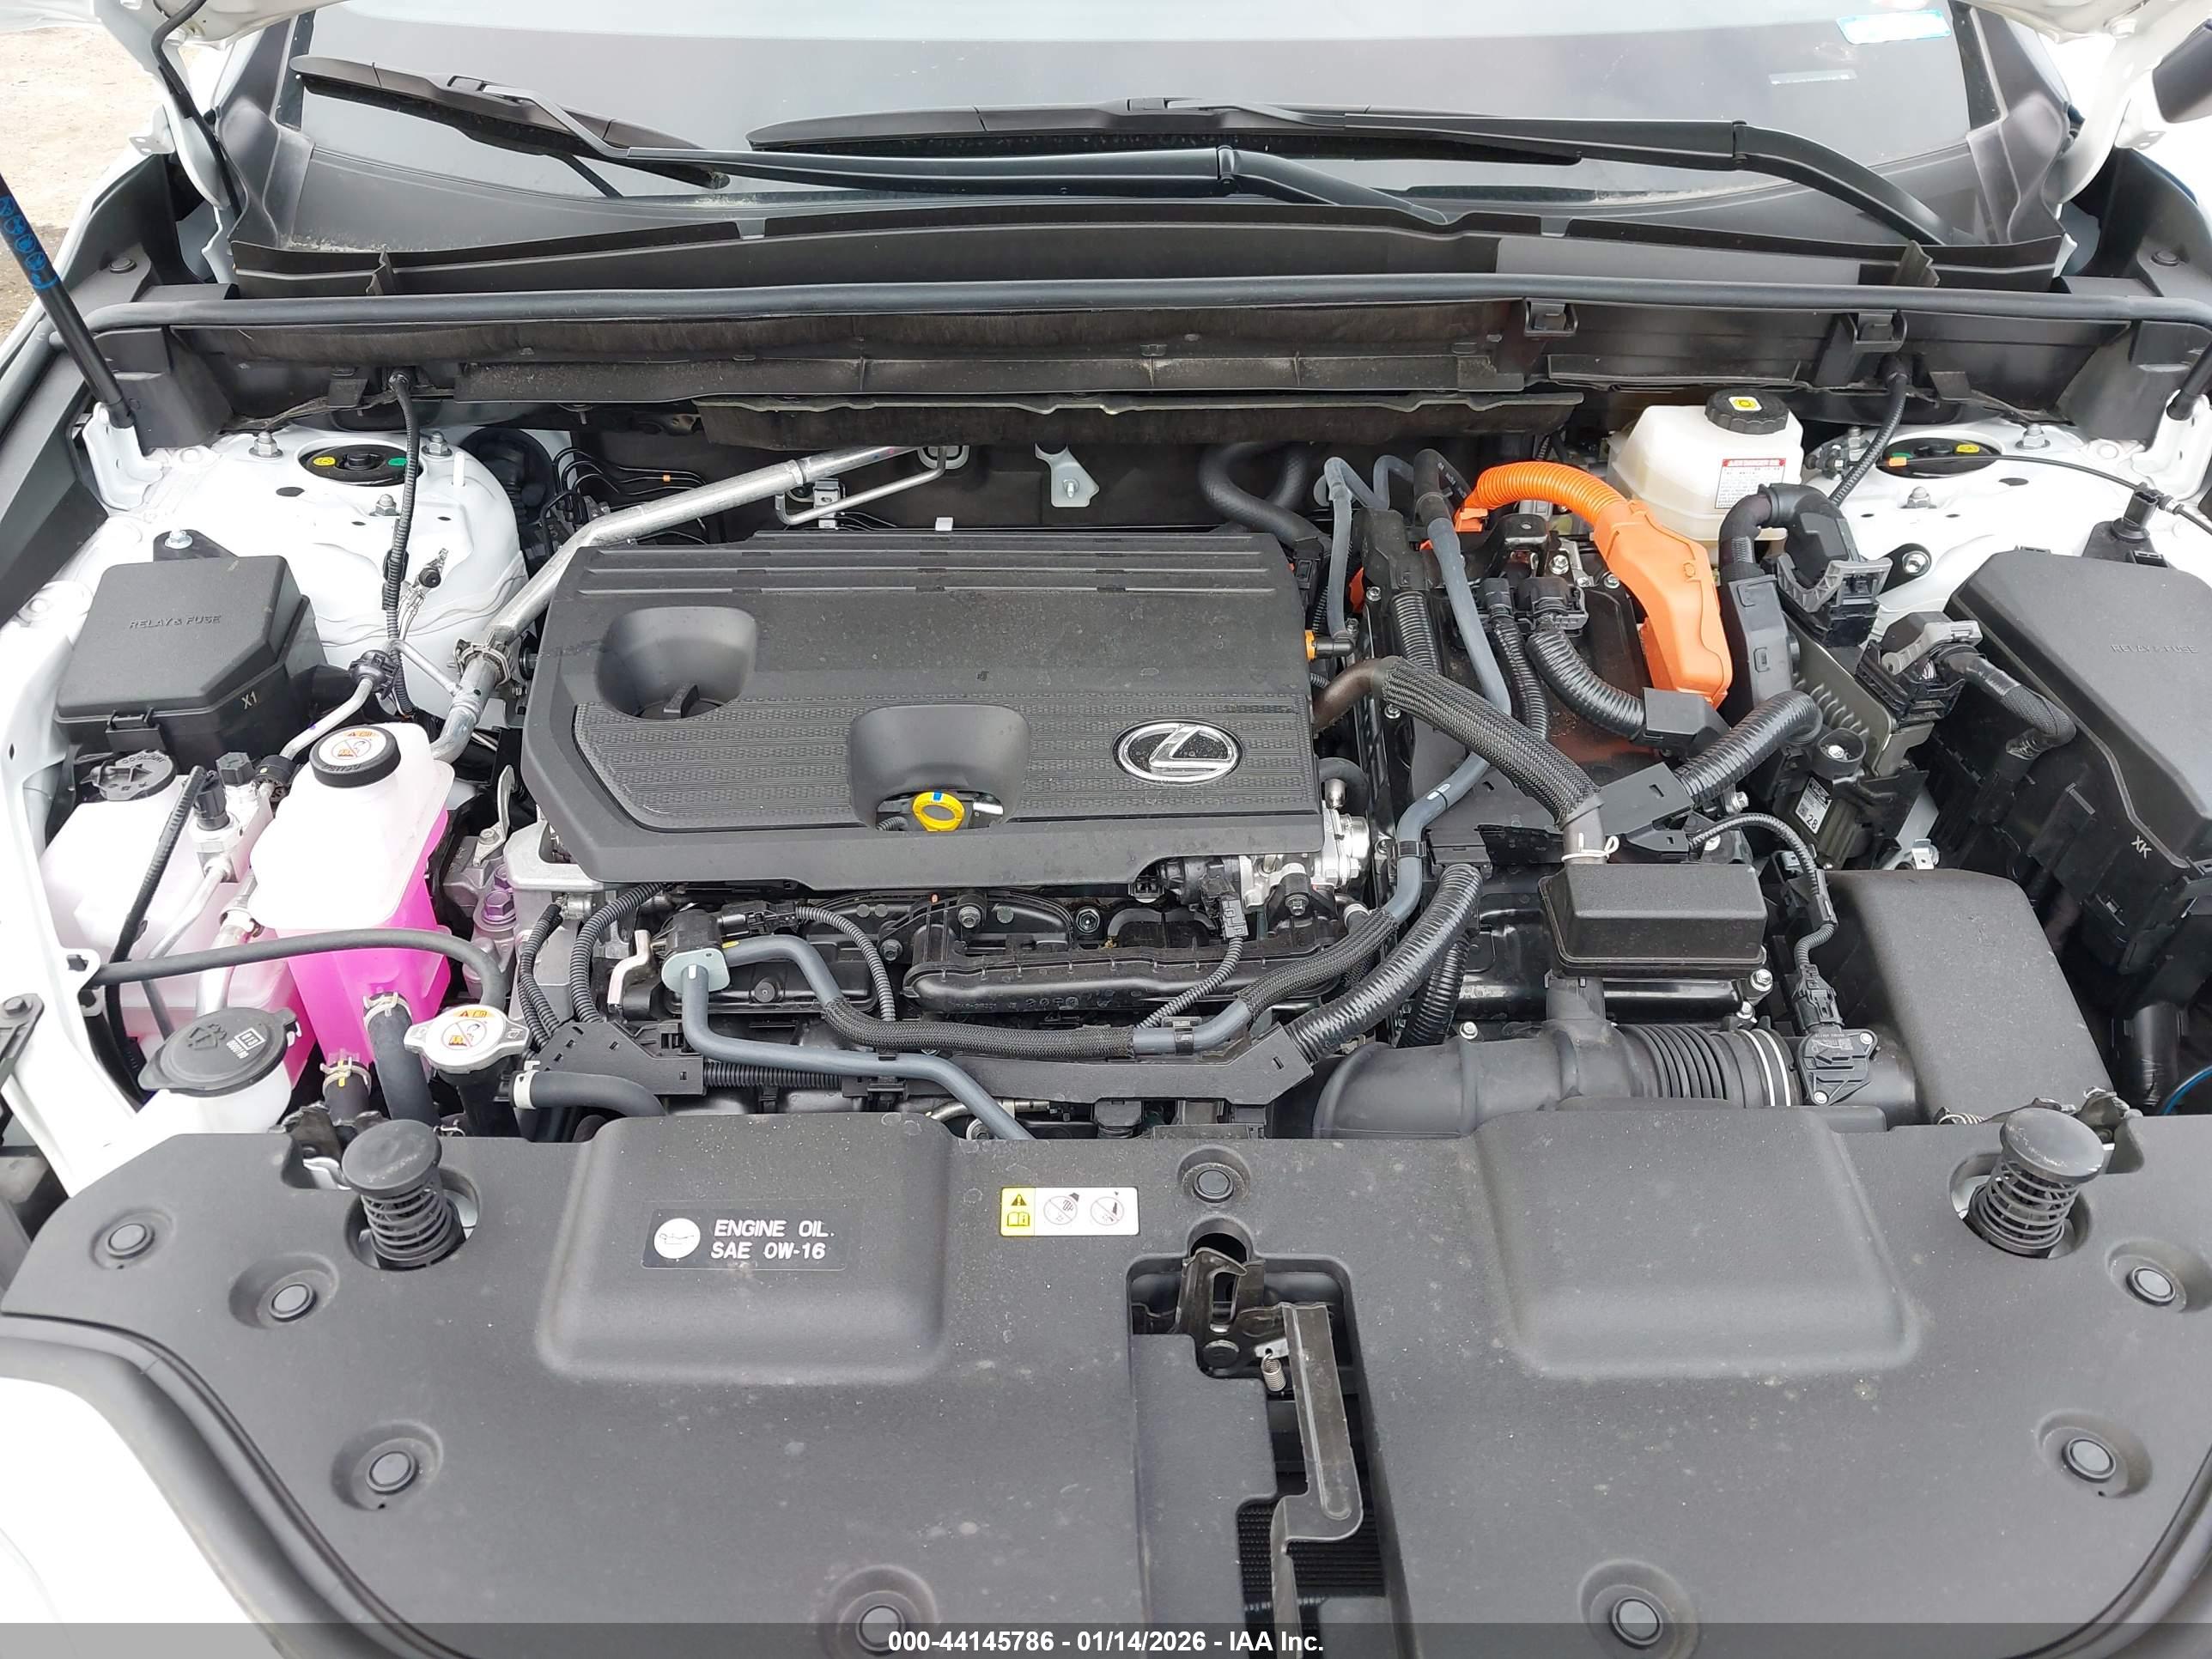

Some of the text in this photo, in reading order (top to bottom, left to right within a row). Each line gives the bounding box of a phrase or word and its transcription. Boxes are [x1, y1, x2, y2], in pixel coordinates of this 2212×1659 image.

[130, 618, 173, 629] RELAY
[185, 615, 222, 625] FUSE
[241, 690, 258, 710] X1
[1806, 814, 1819, 830] 28
[2130, 835, 2153, 860] XK
[714, 1219, 787, 1237] ENGINE
[710, 1242, 753, 1259] SAE
